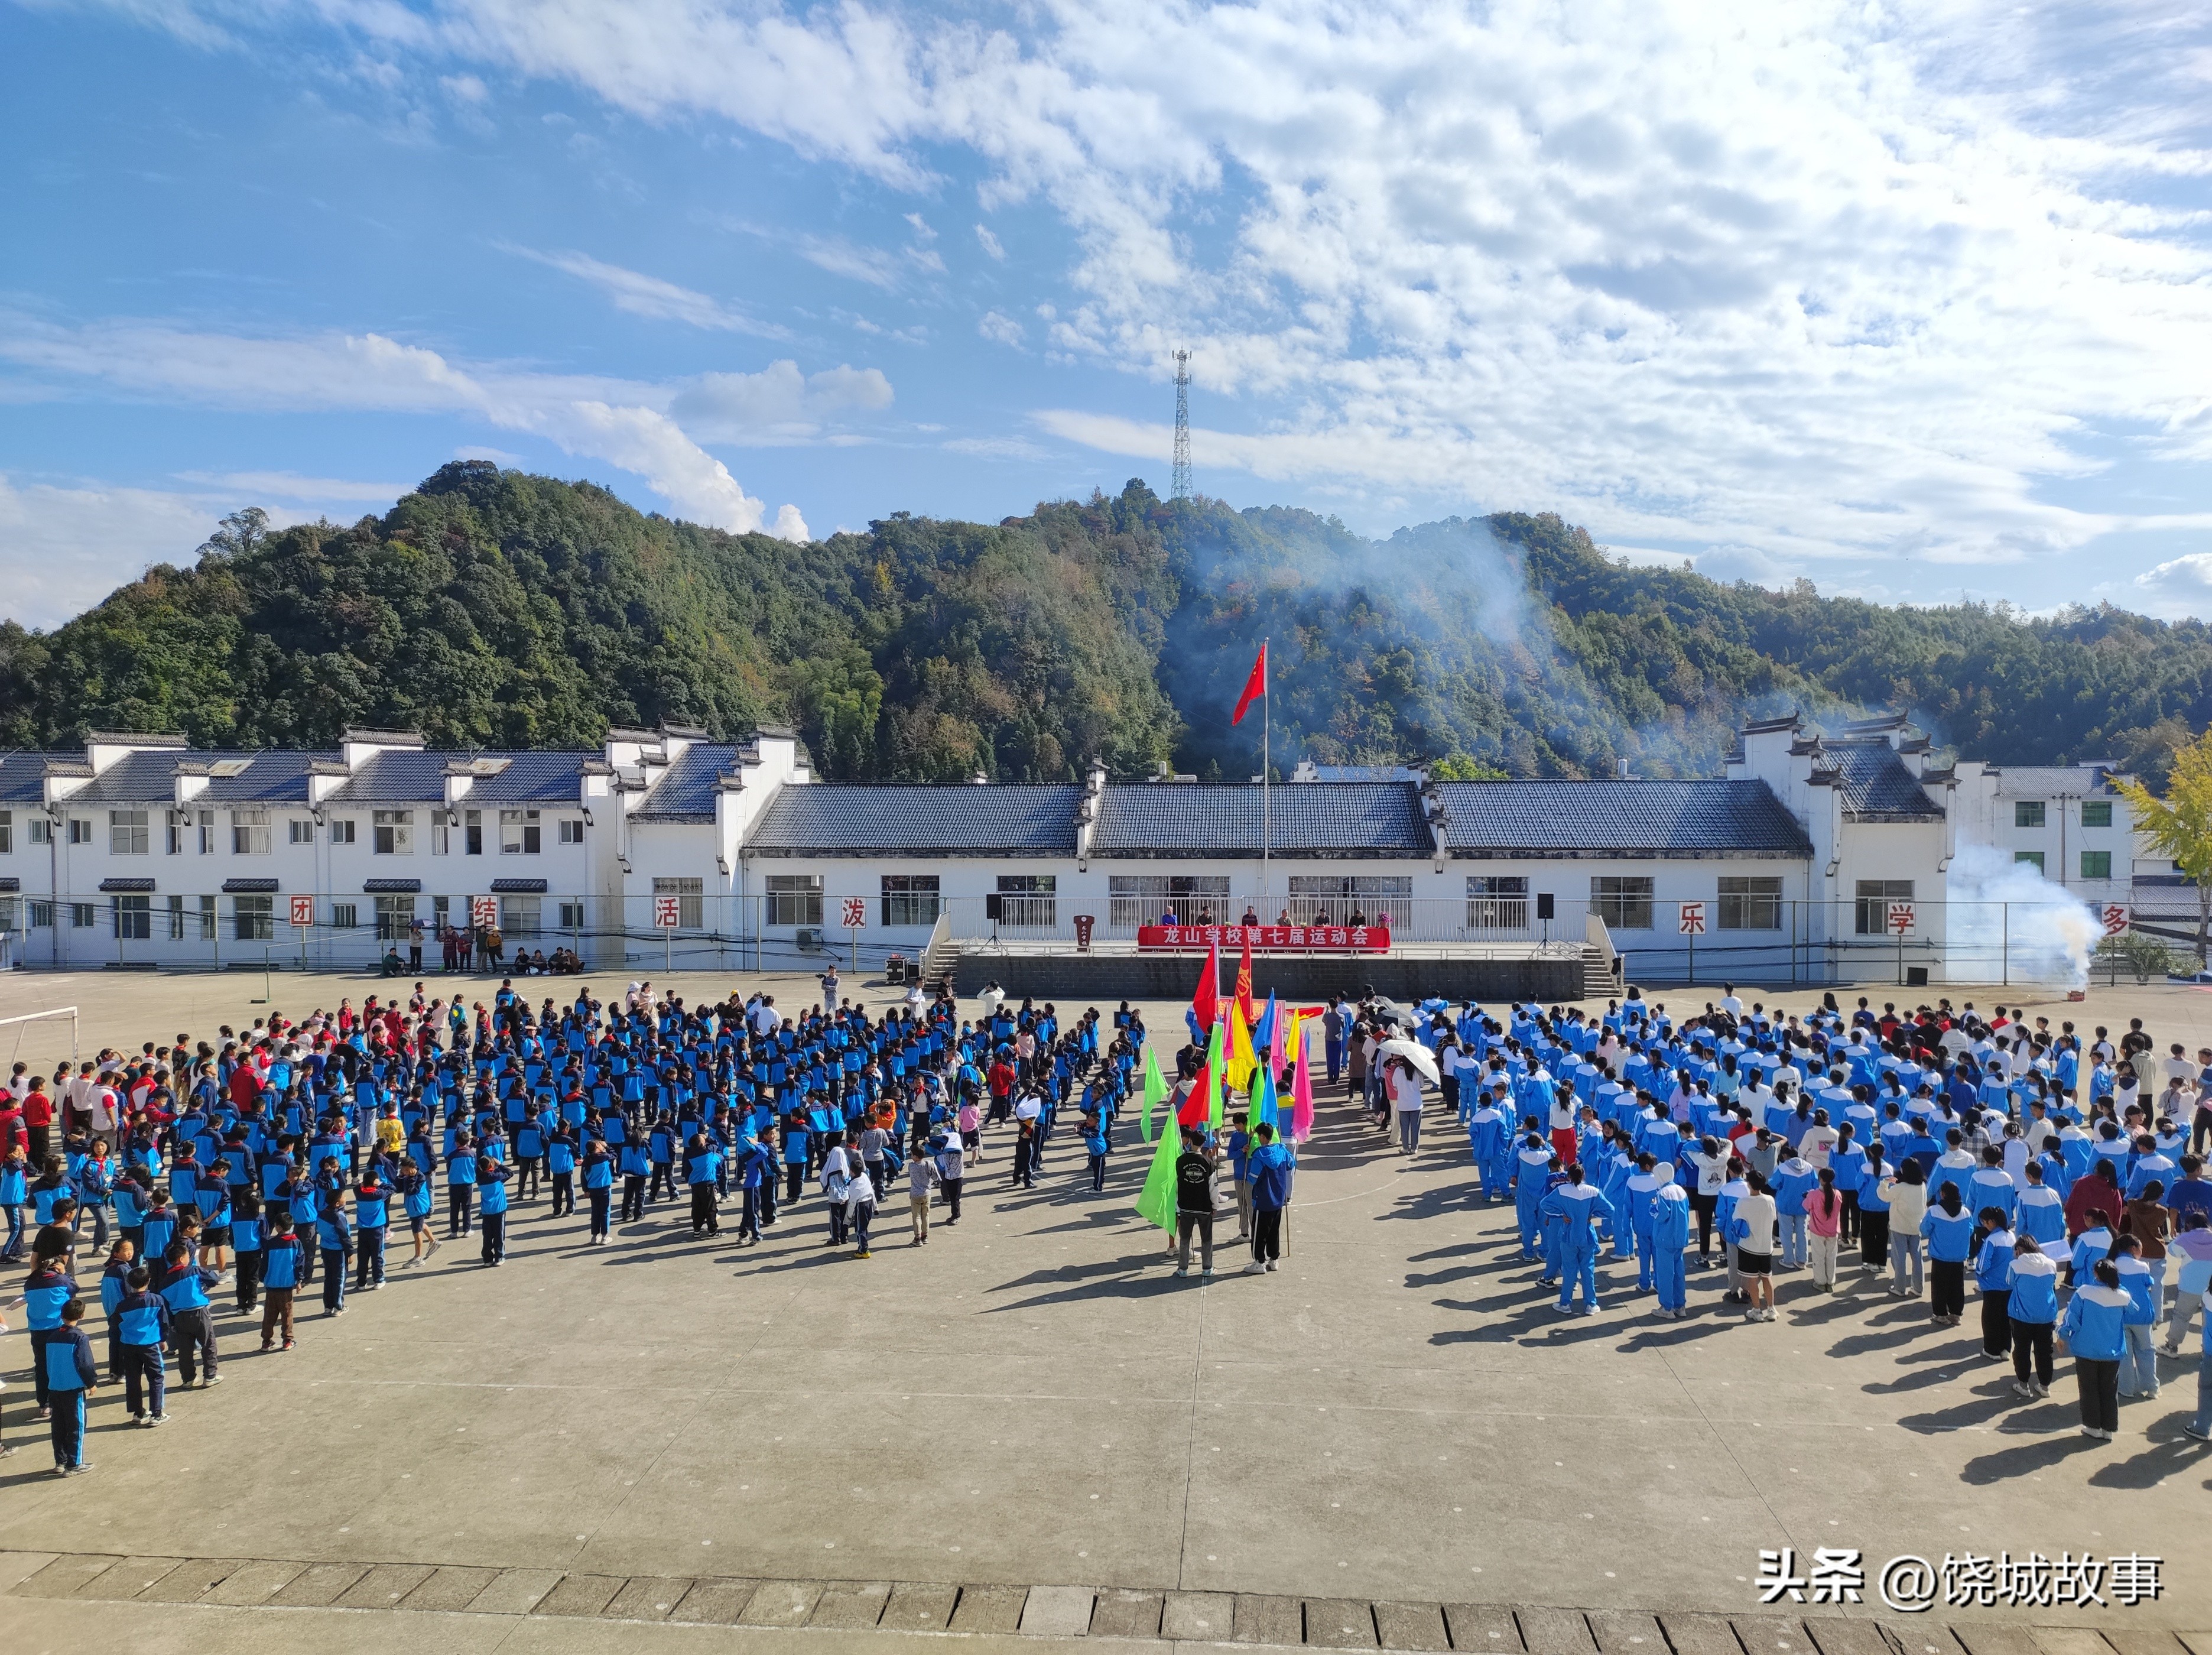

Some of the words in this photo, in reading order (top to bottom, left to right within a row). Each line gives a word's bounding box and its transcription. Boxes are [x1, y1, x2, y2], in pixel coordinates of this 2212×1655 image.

[291, 897, 312, 924] 团
[475, 897, 496, 925] 结
[657, 898, 678, 926] 活
[842, 898, 865, 927] 泼
[1680, 903, 1704, 933] 乐
[1889, 904, 1914, 934] 学
[2103, 906, 2127, 936] 多
[1164, 927, 1368, 945] 龙山学校第七届运动会
